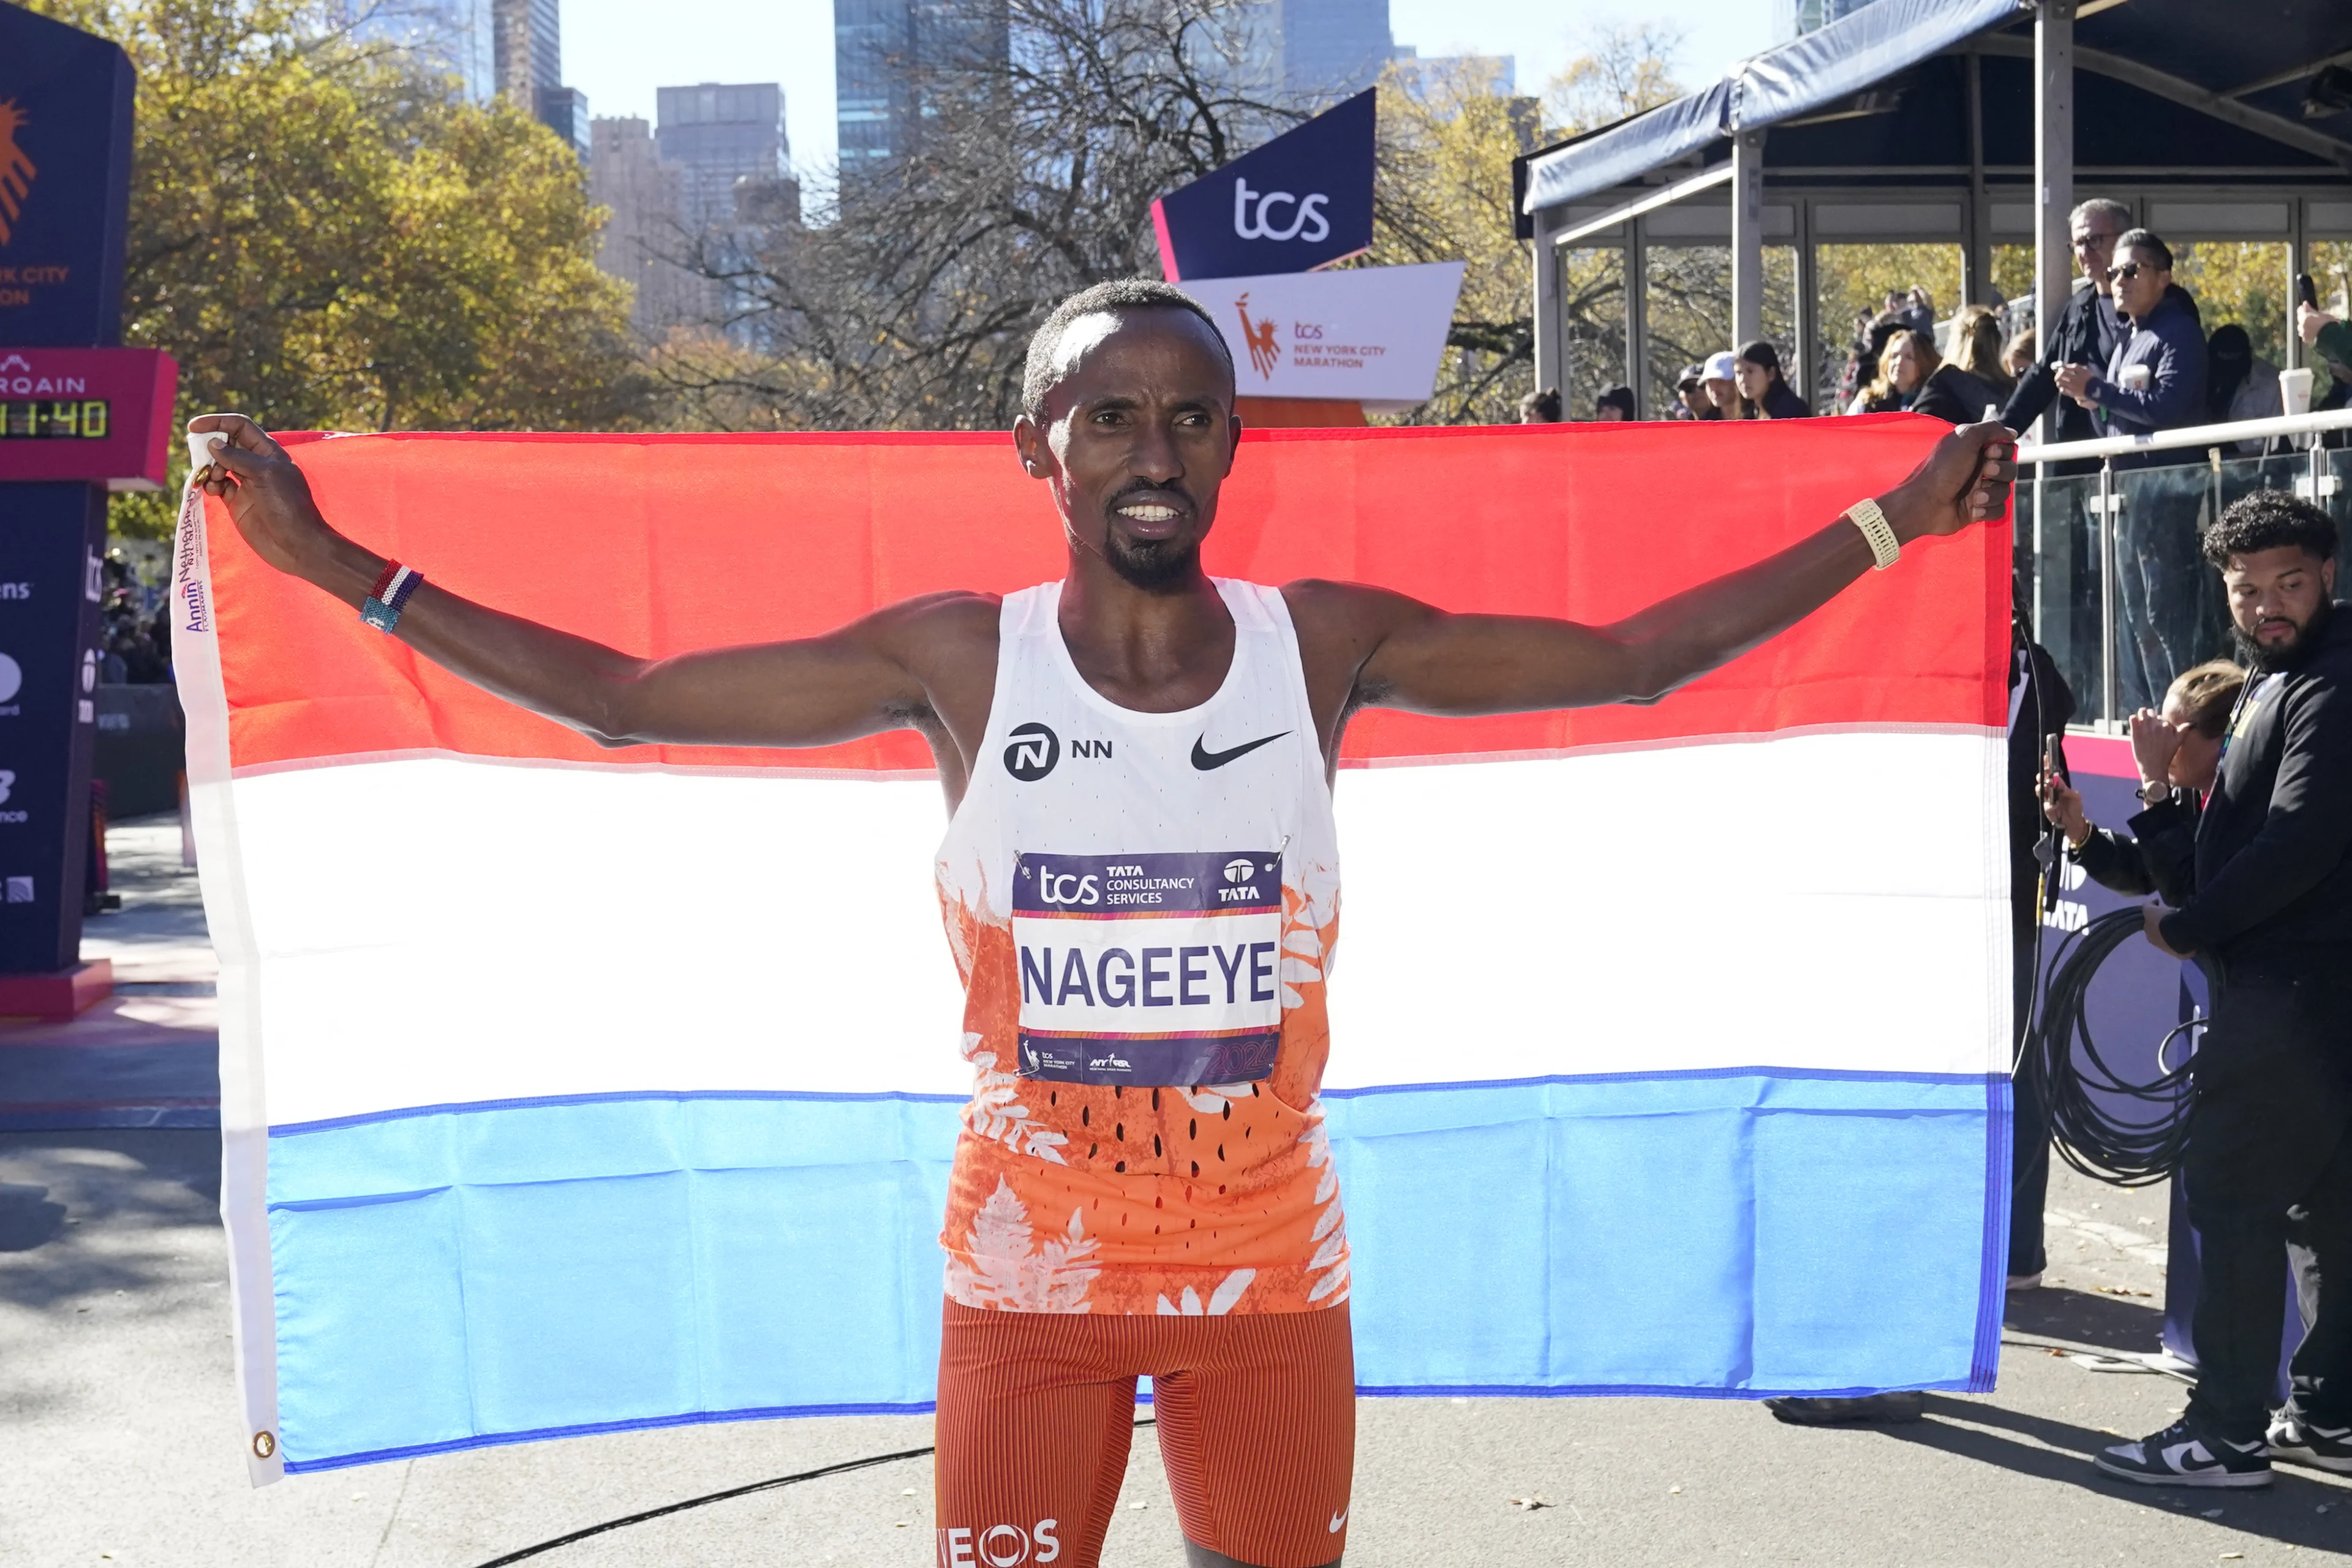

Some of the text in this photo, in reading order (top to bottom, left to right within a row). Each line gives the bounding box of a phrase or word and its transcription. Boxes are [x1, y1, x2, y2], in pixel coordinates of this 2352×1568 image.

[1234, 176, 1330, 243] tcs
[22, 266, 69, 284] CITY
[1294, 321, 1323, 339] tcs
[1294, 344, 1386, 356] NEW YORK CITY
[1294, 358, 1364, 368] MARATHON
[0, 582, 30, 599] ns
[186, 581, 203, 633] Annin
[198, 581, 209, 632] FLAGMAKERS
[1071, 740, 1112, 759] NN
[1106, 865, 1144, 877] TATA
[1040, 865, 1099, 905] tcs
[1106, 878, 1194, 891] CONSULTANCY
[1106, 892, 1163, 905] SERVICES
[1218, 886, 1261, 902] TATA
[1021, 941, 1275, 1008] NAGEEYE
[1204, 1039, 1274, 1077] 2024
